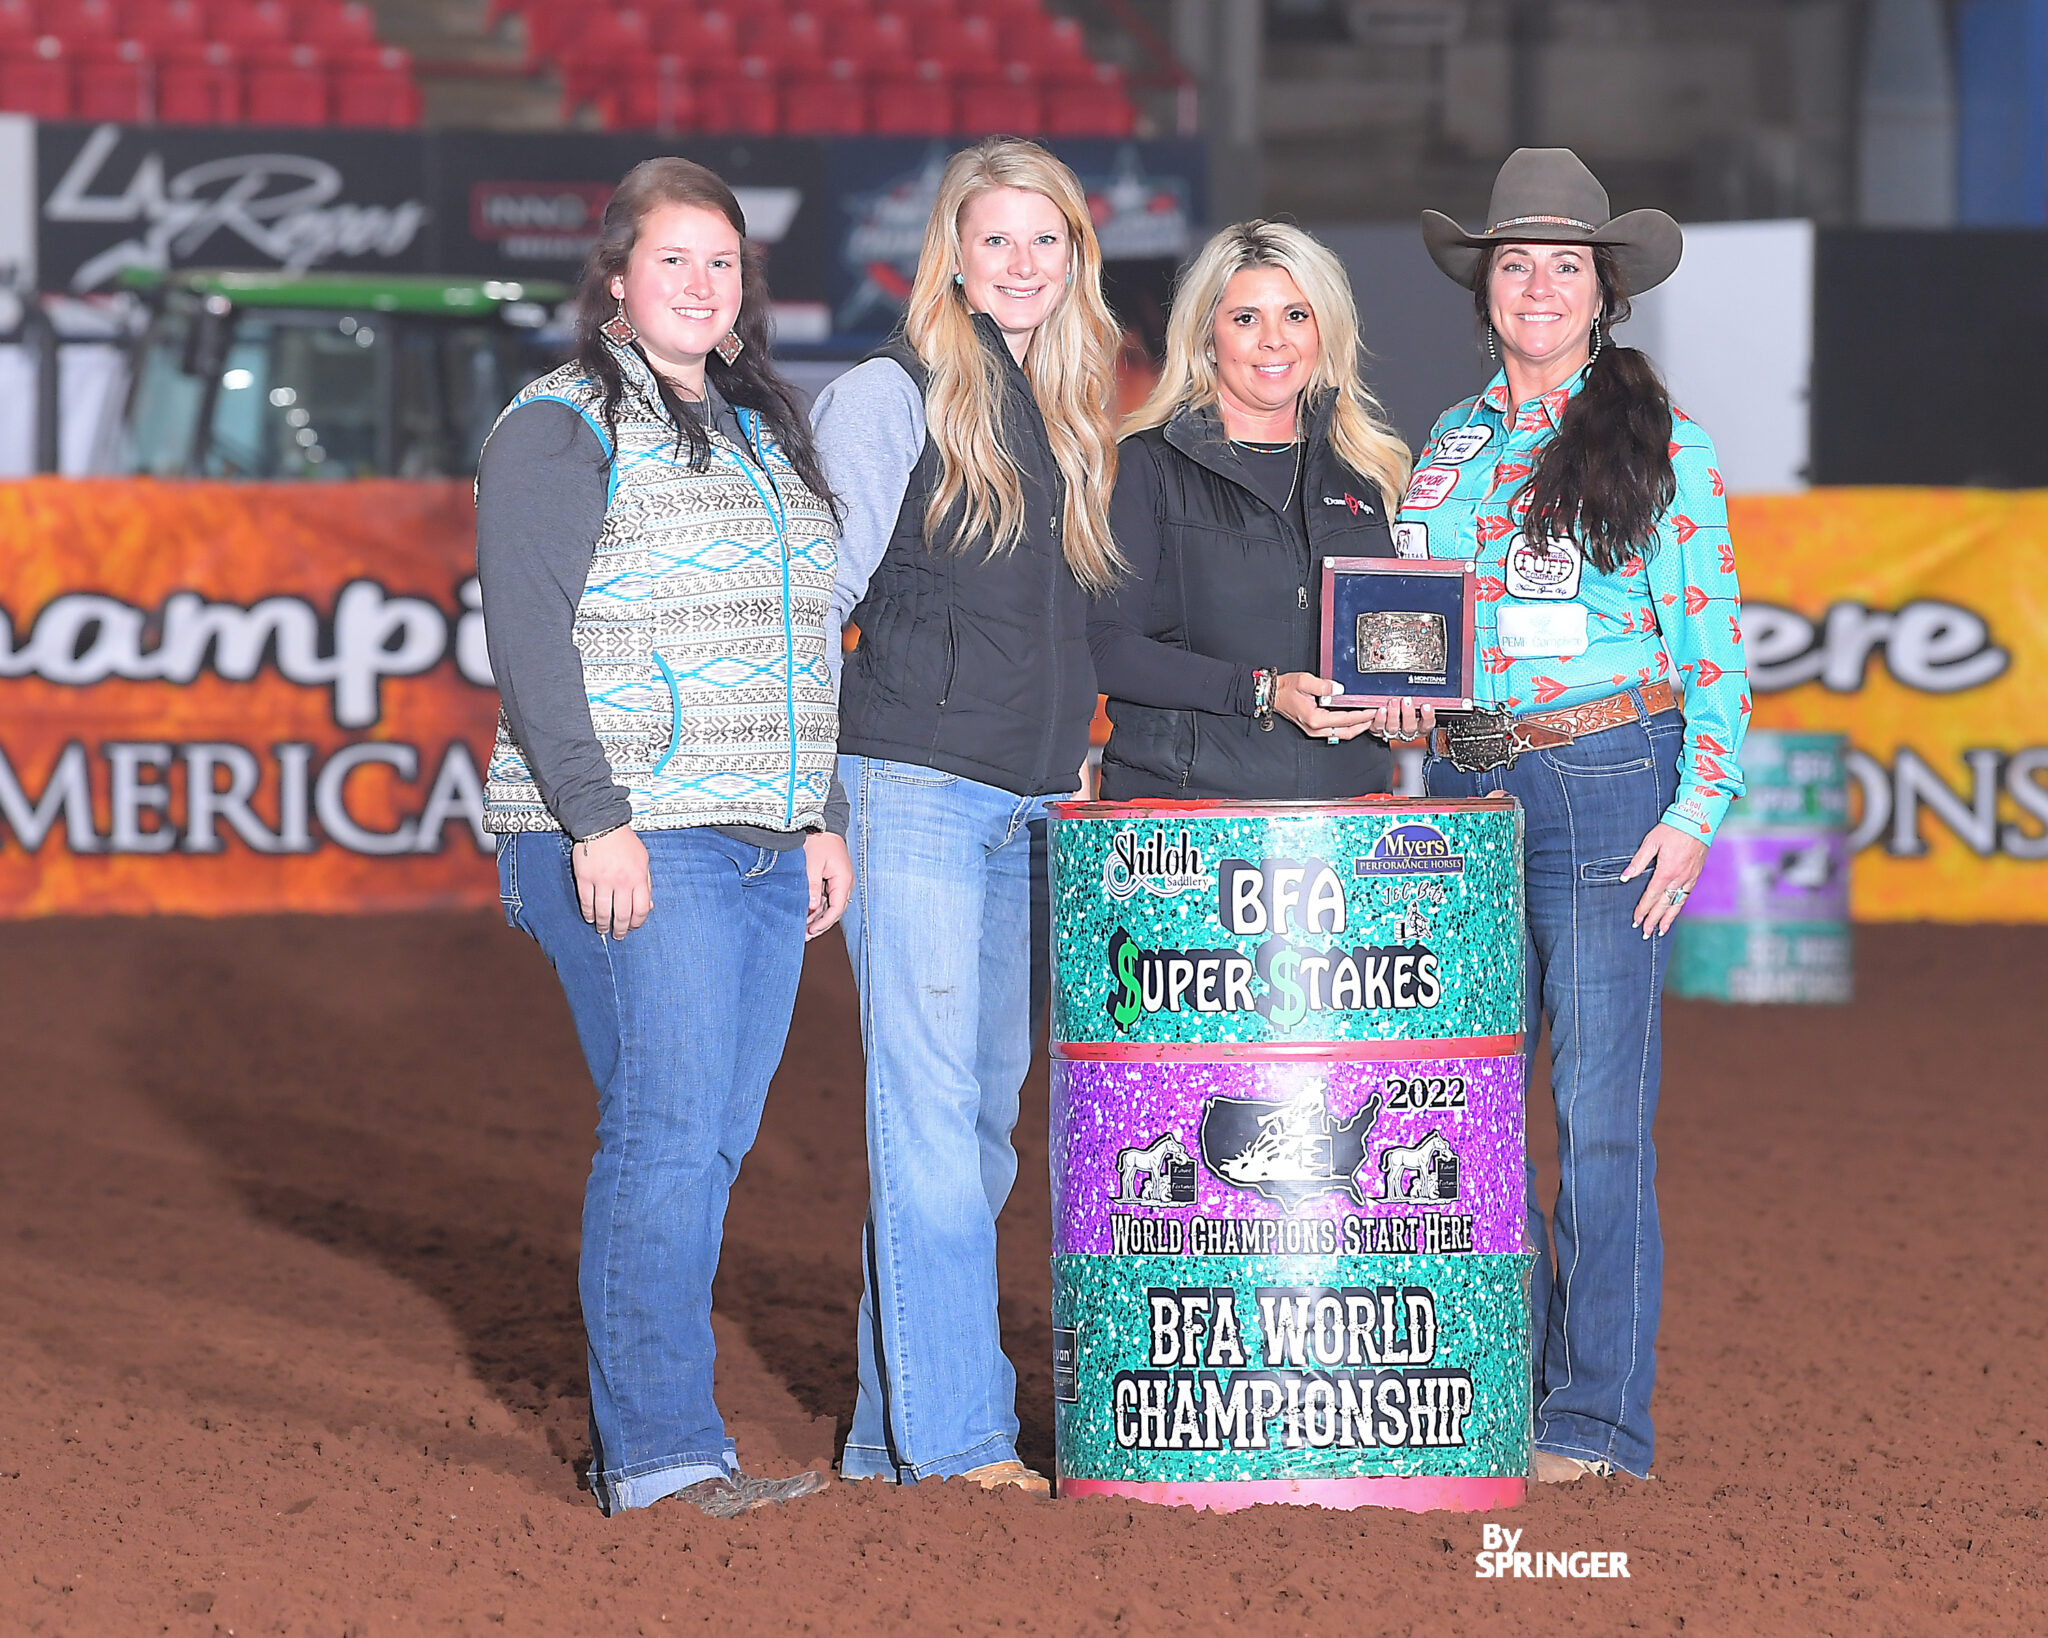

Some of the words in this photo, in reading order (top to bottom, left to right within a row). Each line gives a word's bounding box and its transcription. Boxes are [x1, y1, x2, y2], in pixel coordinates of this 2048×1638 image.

[1516, 549, 1570, 576] TUFF
[1525, 570, 1561, 582] COMPANY
[1383, 834, 1445, 862] Myers
[1104, 832, 1204, 897] Shiloh
[1360, 860, 1429, 871] PERFORMANCE
[1430, 859, 1461, 869] HORSES
[1166, 875, 1209, 889] Saddlery
[1221, 859, 1346, 936] BFA
[1387, 1077, 1466, 1109] 2022
[1110, 1214, 1183, 1255] WORLD
[1190, 1216, 1336, 1255] CHAMPIONS
[1343, 1215, 1420, 1254] START
[1424, 1212, 1472, 1254] HERE
[1150, 1290, 1246, 1367] BFA
[1260, 1290, 1438, 1365] WORLD
[1114, 1372, 1473, 1450] CHAMPIONSHIP
